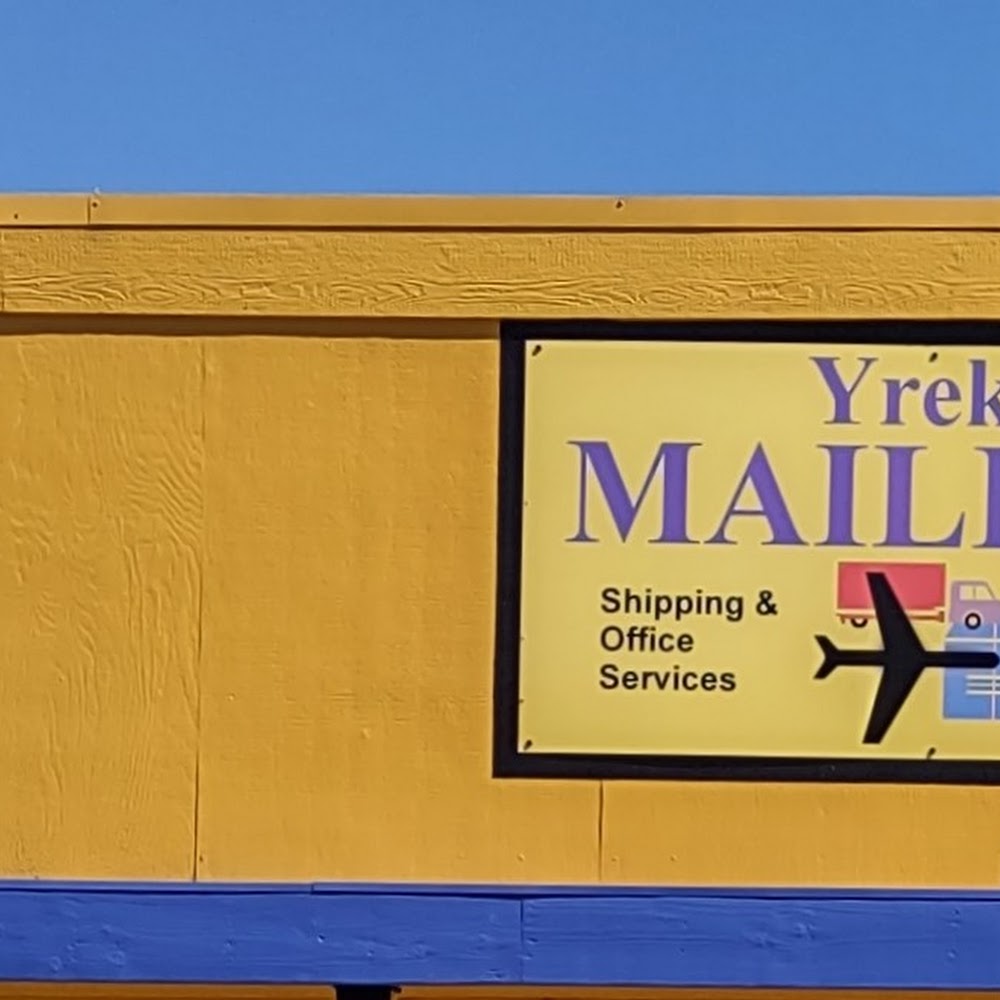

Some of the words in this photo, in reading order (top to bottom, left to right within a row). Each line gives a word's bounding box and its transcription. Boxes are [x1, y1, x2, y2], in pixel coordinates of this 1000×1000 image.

[600, 587, 745, 622] Shipping
[755, 590, 778, 617] &
[600, 625, 695, 653] Office
[599, 664, 737, 692] Services
